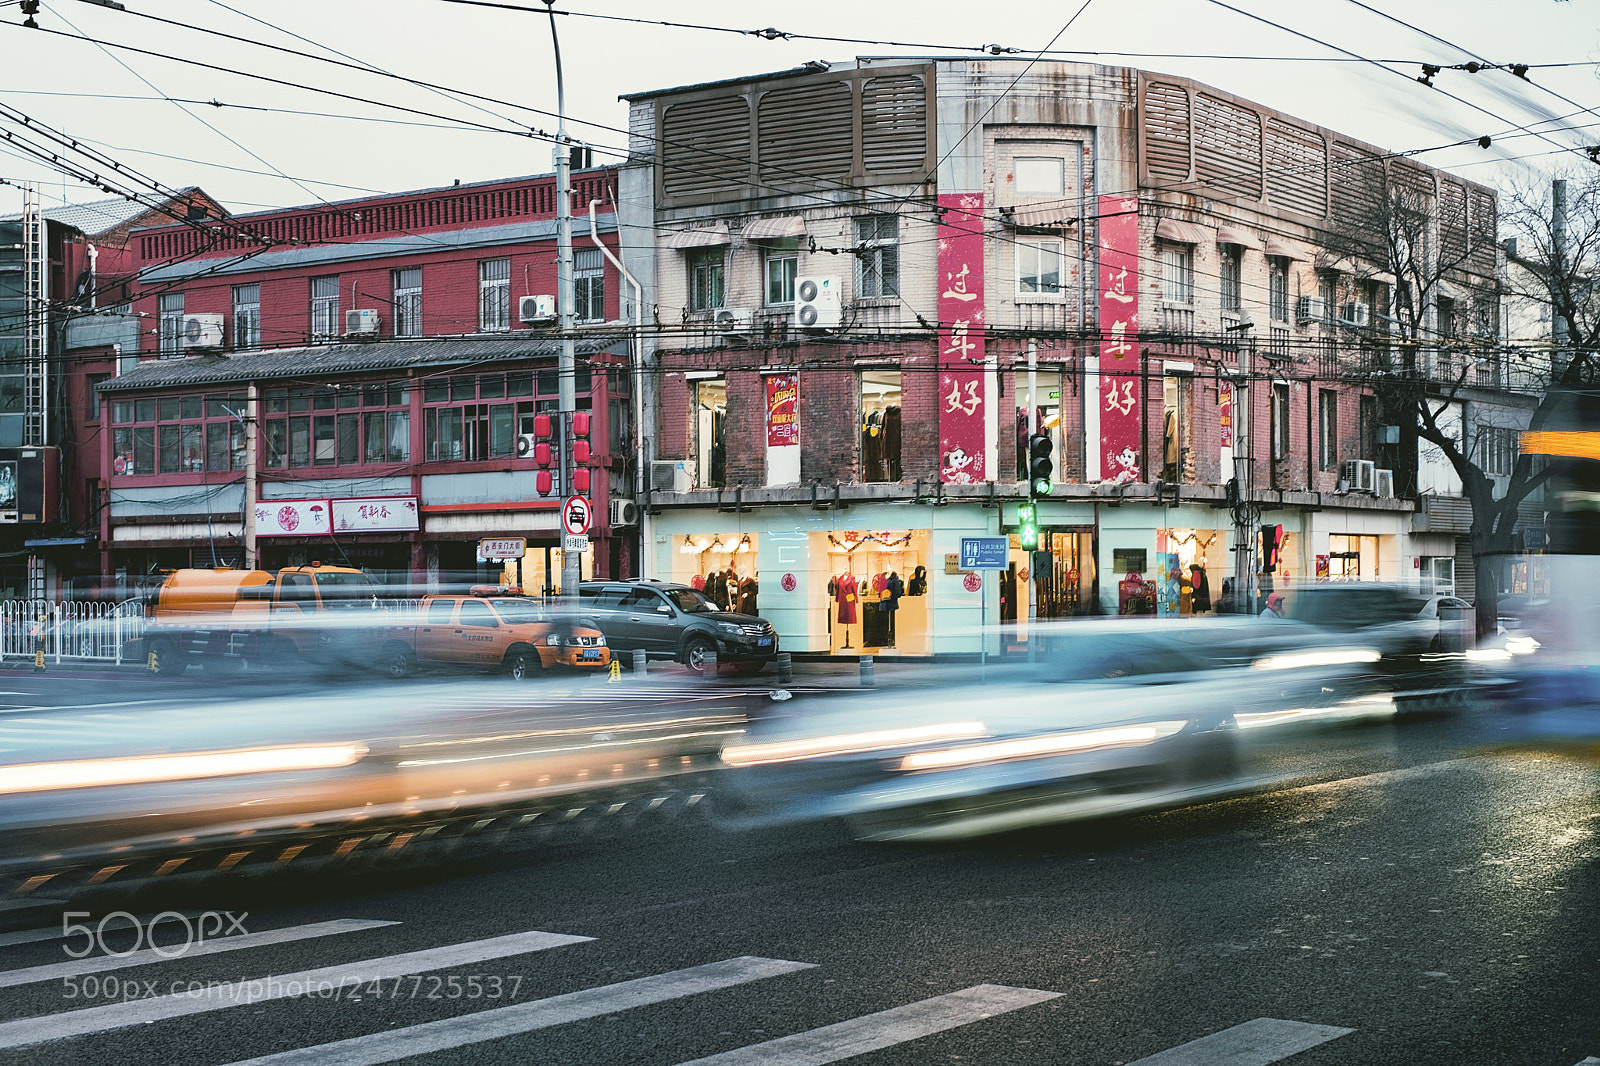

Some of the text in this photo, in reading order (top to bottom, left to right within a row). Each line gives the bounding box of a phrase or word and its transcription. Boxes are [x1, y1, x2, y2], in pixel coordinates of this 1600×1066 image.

[942, 263, 982, 416] 过年好
[1104, 266, 1136, 416] 过年好
[492, 541, 521, 550] 西安门大街
